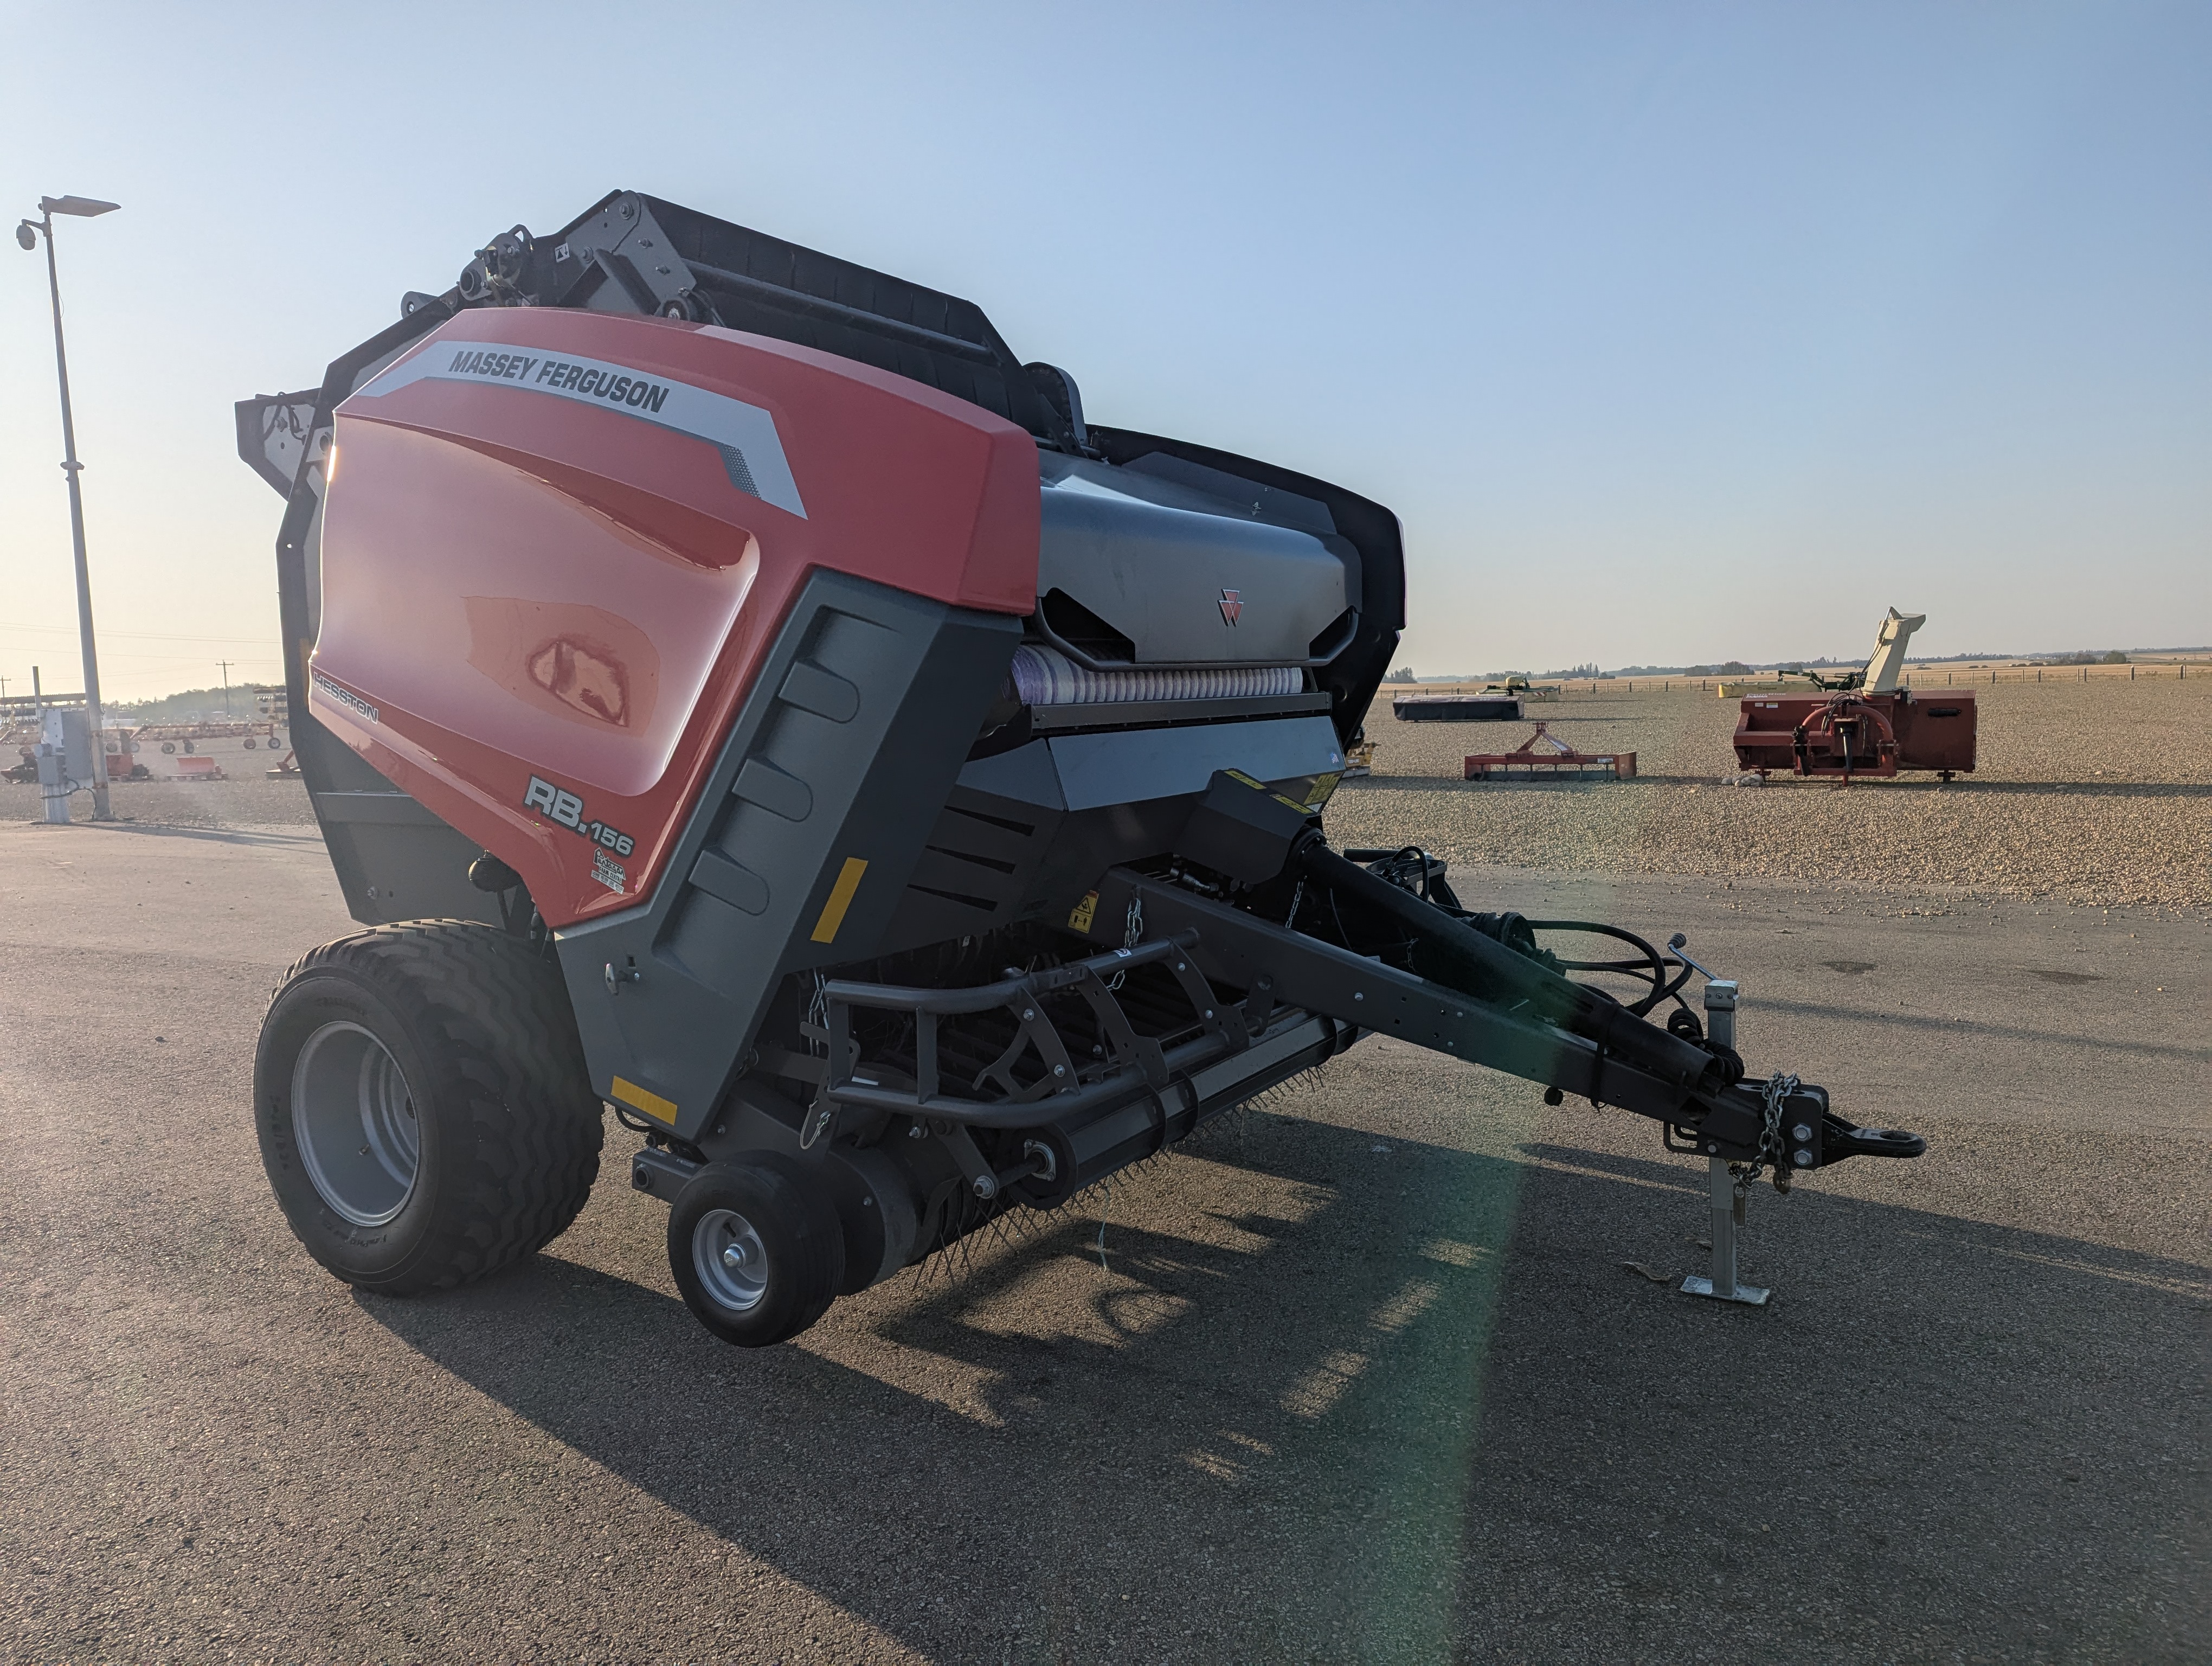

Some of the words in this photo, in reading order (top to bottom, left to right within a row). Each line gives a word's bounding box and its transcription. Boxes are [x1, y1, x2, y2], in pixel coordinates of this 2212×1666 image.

[449, 350, 539, 380] MASSEY
[535, 361, 670, 413] FERGUSON
[313, 671, 378, 725] HESSTON
